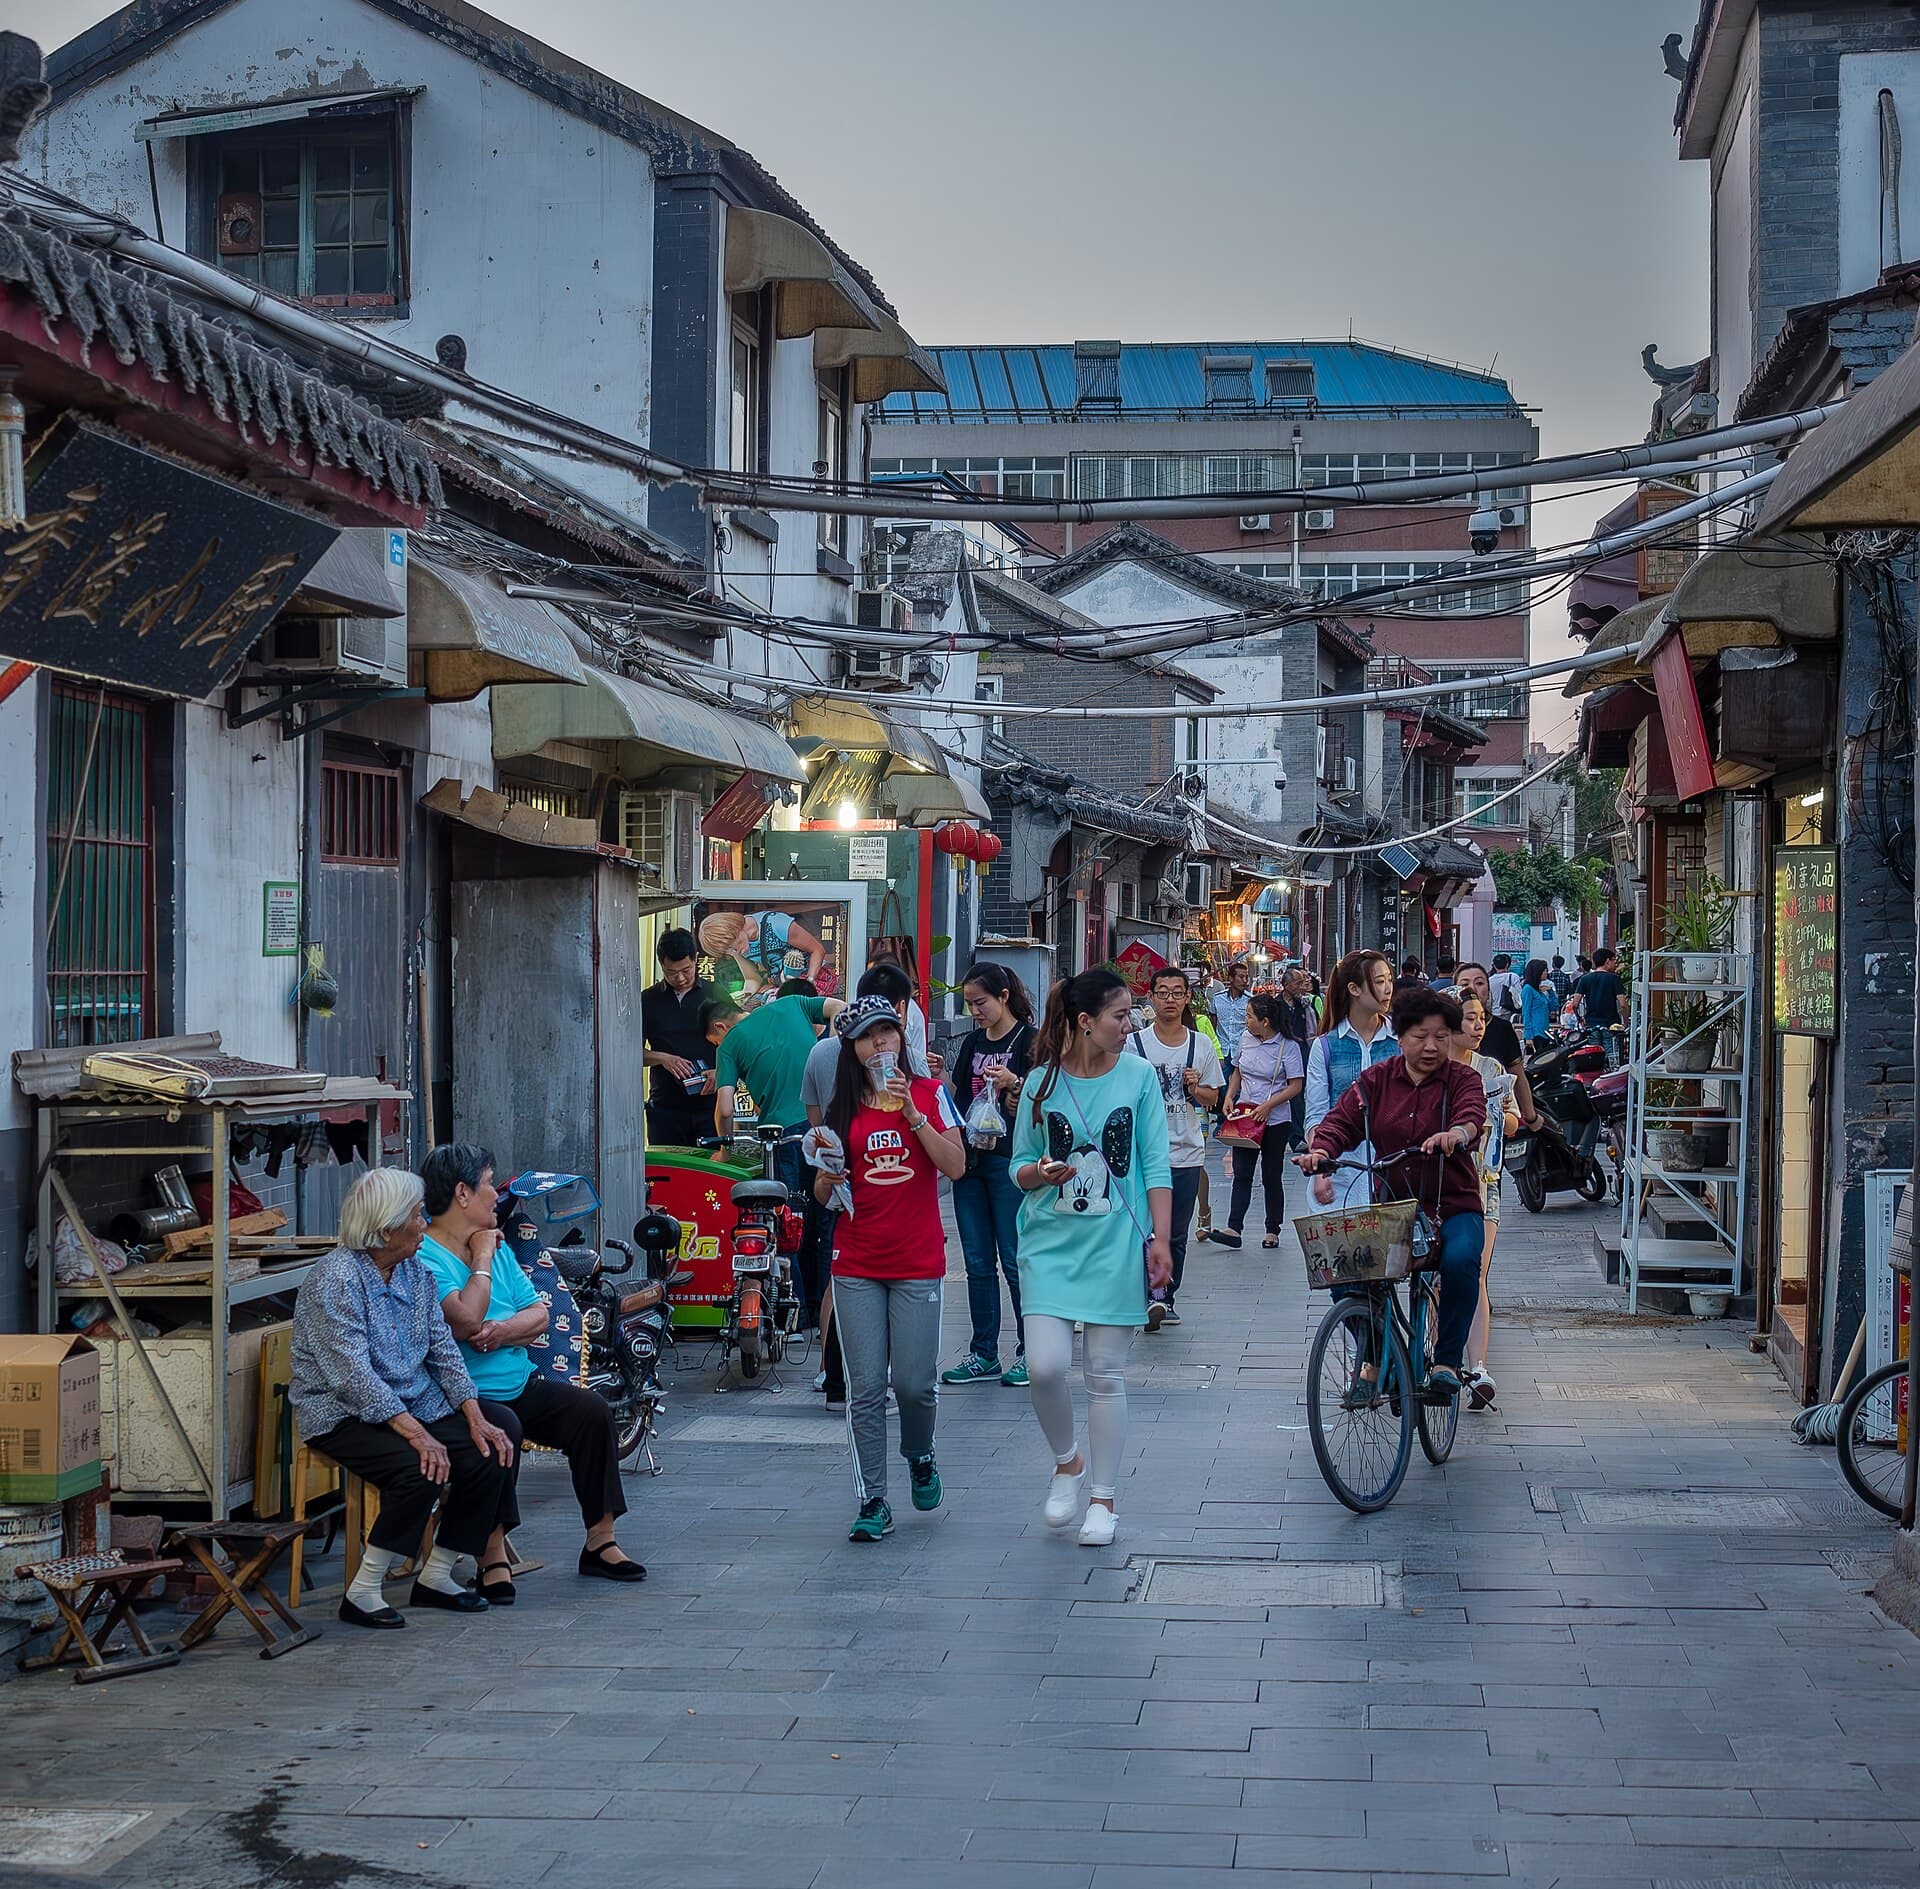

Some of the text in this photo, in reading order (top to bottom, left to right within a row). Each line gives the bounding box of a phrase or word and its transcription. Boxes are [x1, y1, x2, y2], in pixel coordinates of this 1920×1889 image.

[1784, 861, 1834, 890] 创意礼品
[870, 1131, 900, 1149] USA
